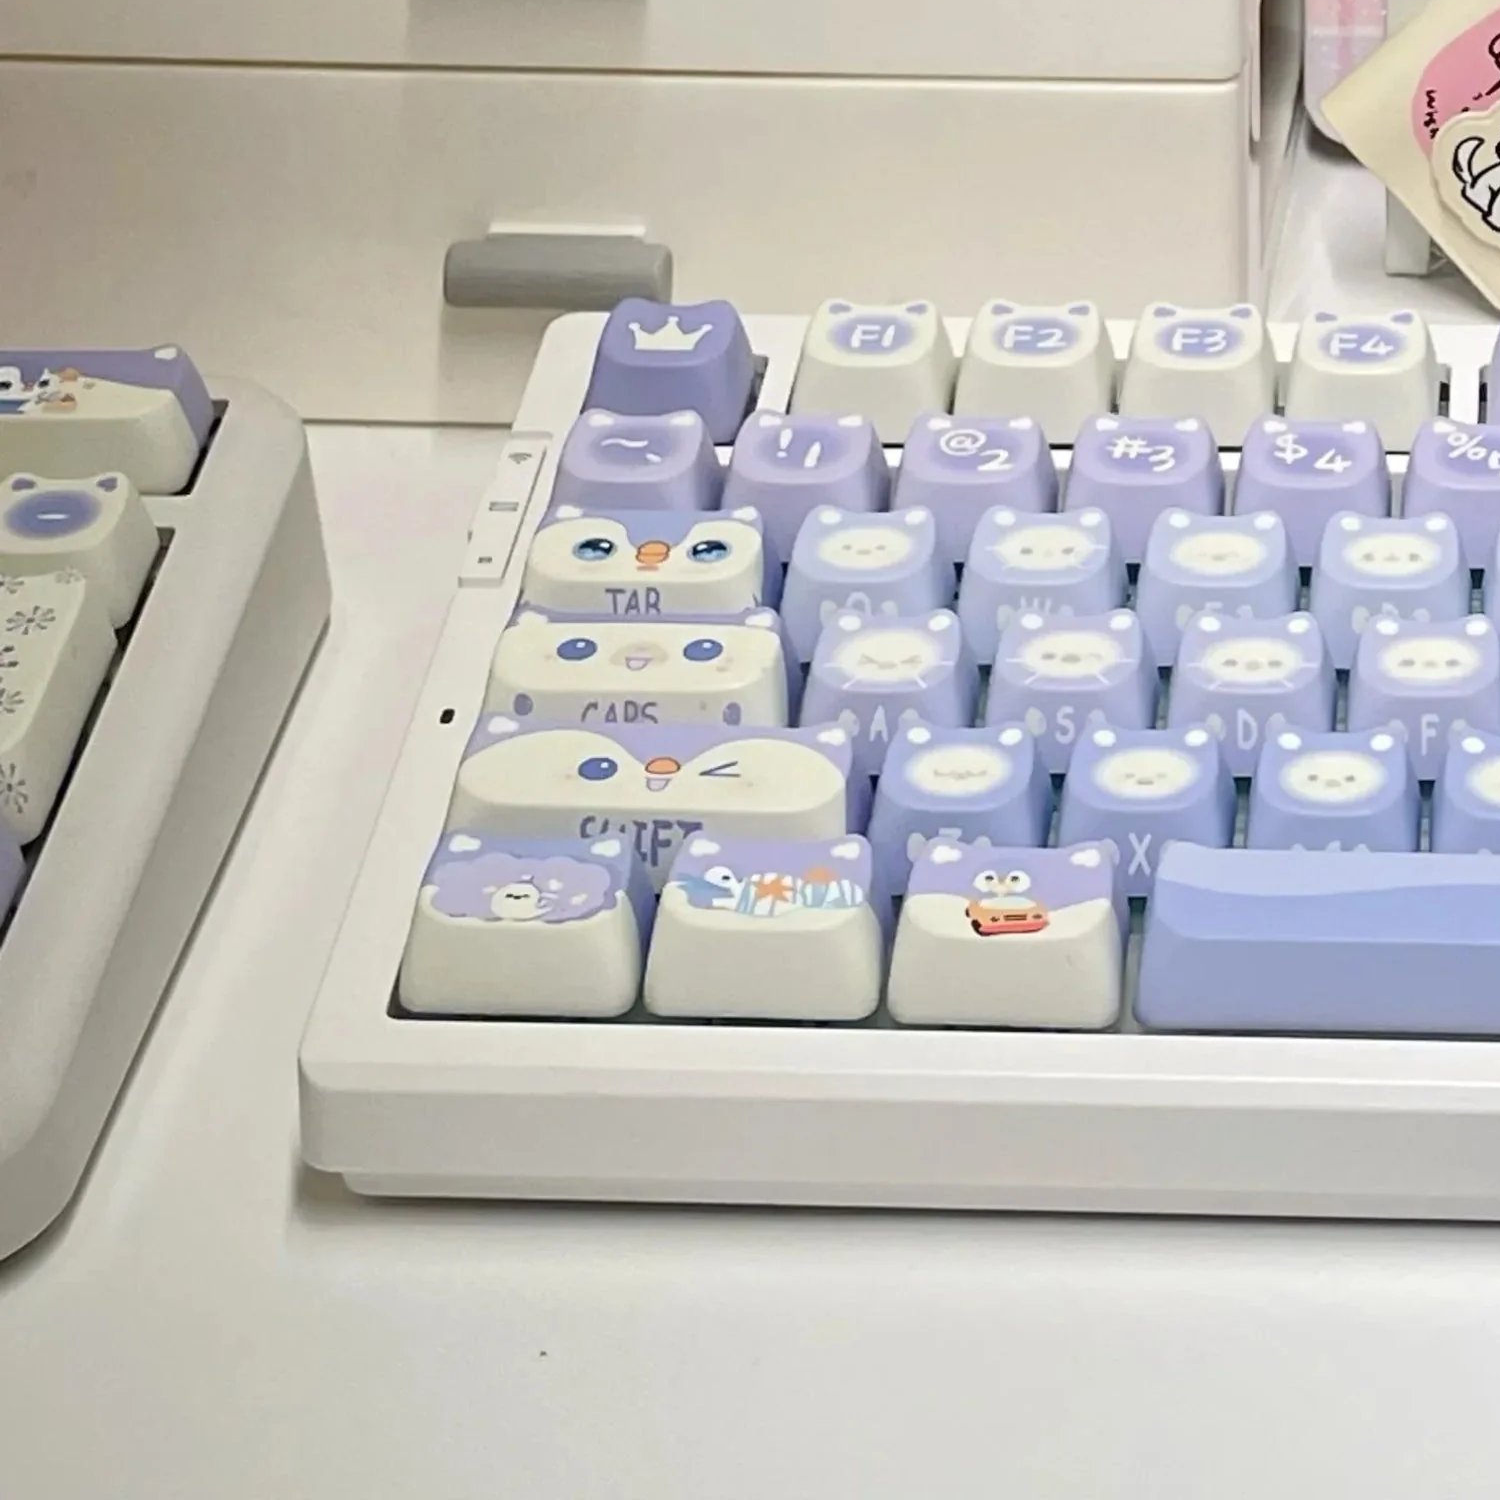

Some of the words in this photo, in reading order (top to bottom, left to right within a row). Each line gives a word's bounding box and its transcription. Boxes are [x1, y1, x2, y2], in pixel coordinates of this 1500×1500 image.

[849, 323, 898, 348] F1
[1002, 325, 1068, 350] F2
[1170, 327, 1229, 352] F3
[1328, 332, 1396, 358] F4
[869, 704, 889, 743] A
[1055, 705, 1076, 744] S
[1236, 707, 1258, 750] D
[1420, 713, 1440, 757] F
[1127, 832, 1153, 876] X
